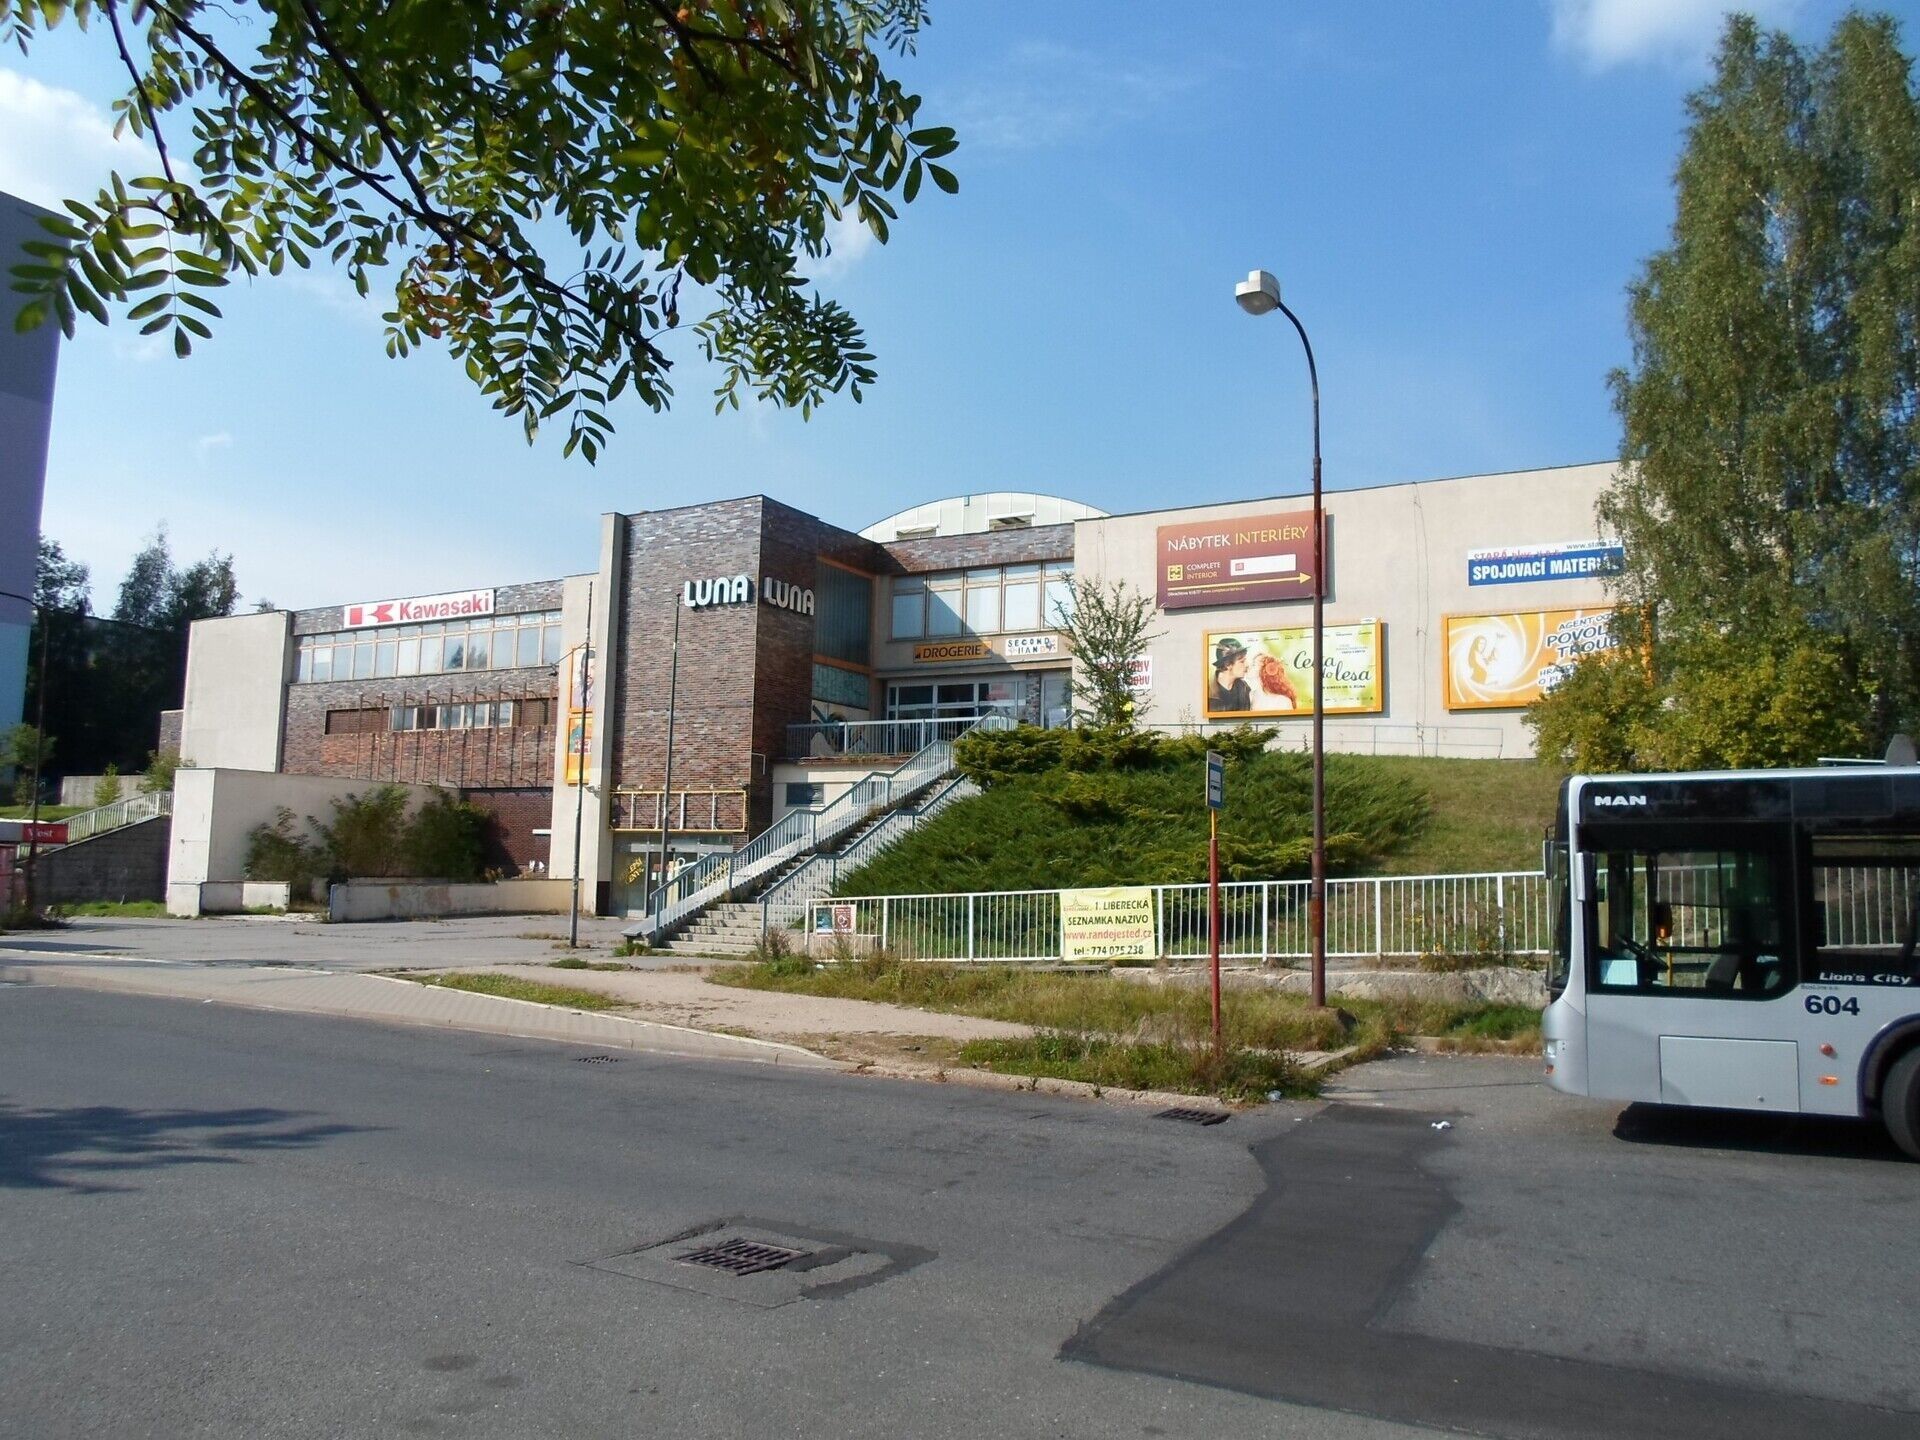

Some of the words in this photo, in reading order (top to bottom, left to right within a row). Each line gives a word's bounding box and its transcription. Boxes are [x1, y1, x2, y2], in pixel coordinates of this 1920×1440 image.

[1168, 534, 1231, 552] NÁBYTEK
[1235, 525, 1309, 545] INTERIÉRY
[1187, 561, 1221, 571] COMPLETE
[1473, 557, 1546, 581] SPOJOVACÍ
[1187, 571, 1218, 580] INTERIOR
[684, 575, 748, 607] LUNA
[763, 576, 815, 616] LUNA
[400, 593, 489, 620] Kawasaki
[1559, 616, 1595, 630] AGENT
[1008, 637, 1050, 647] SECOND
[922, 644, 982, 659] DROGERIE
[1335, 660, 1372, 681] lesa
[1595, 795, 1647, 806] MAN
[1068, 915, 1113, 926] SEZNAMKA
[1091, 945, 1107, 956] 774
[1109, 945, 1125, 955] 075
[1127, 944, 1144, 955] 238
[1820, 972, 1866, 982] Lion's
[1872, 974, 1912, 985] City
[1804, 994, 1860, 1016] 604
